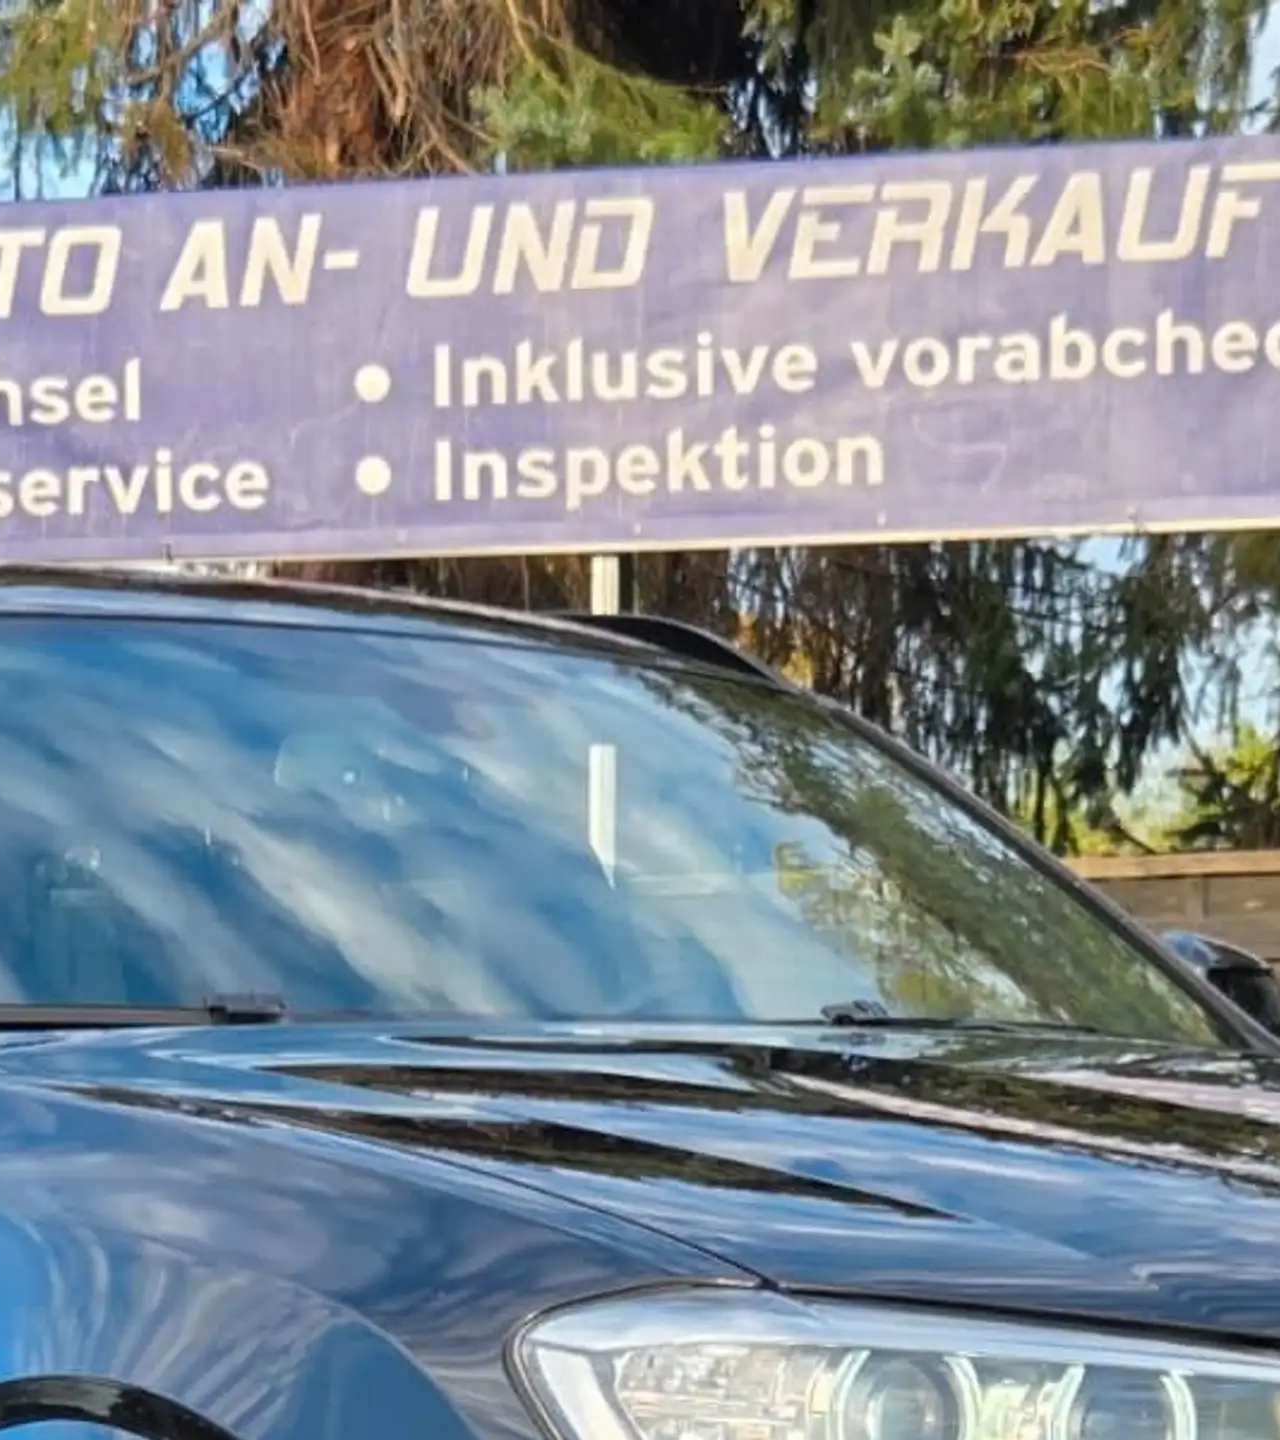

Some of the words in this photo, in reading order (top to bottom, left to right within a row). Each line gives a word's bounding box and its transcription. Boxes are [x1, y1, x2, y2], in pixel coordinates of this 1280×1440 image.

[160, 213, 360, 310] AN-
[406, 197, 656, 298] UND
[434, 332, 817, 408] Inklusive
[434, 424, 885, 511] Inspektion
